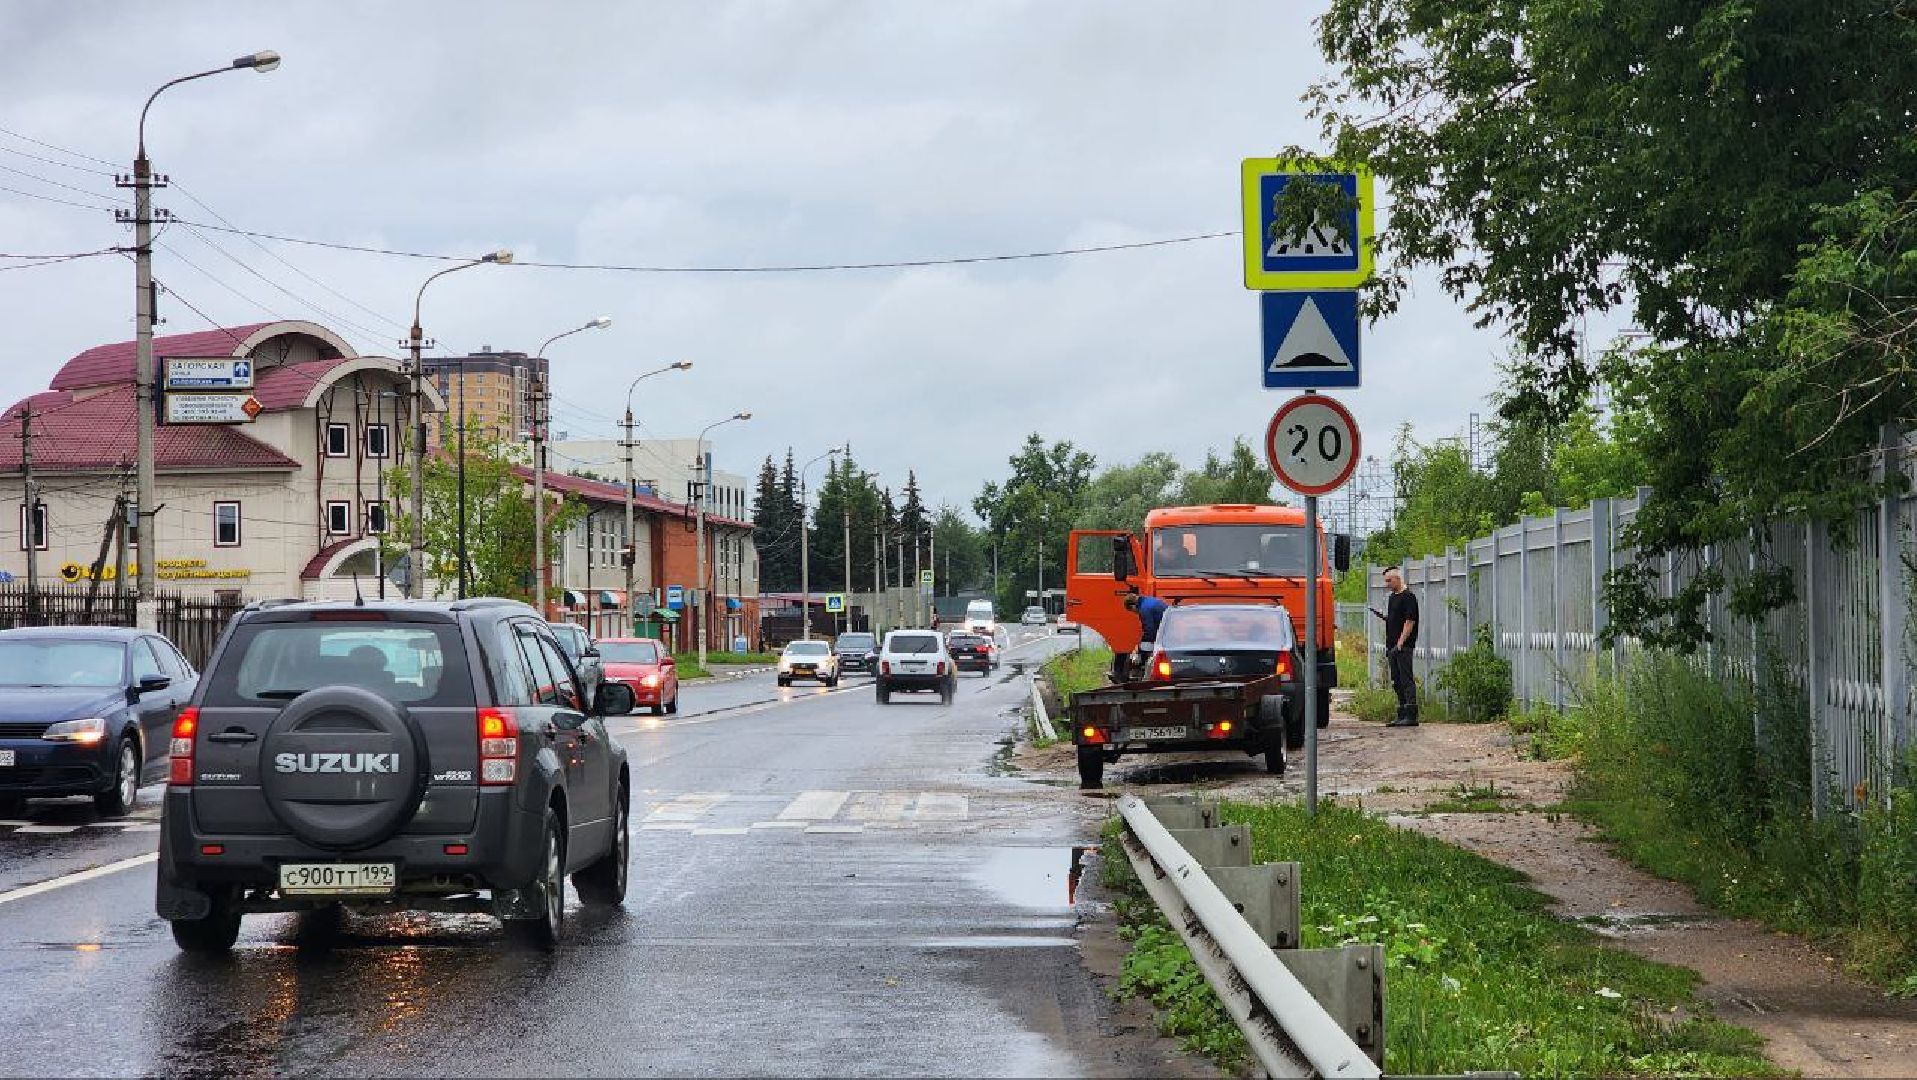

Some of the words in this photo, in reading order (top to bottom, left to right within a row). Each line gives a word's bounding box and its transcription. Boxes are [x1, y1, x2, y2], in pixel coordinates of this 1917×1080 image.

[1287, 424, 1342, 462] 20
[275, 752, 399, 773] SUZUKI
[362, 866, 390, 880] 199
